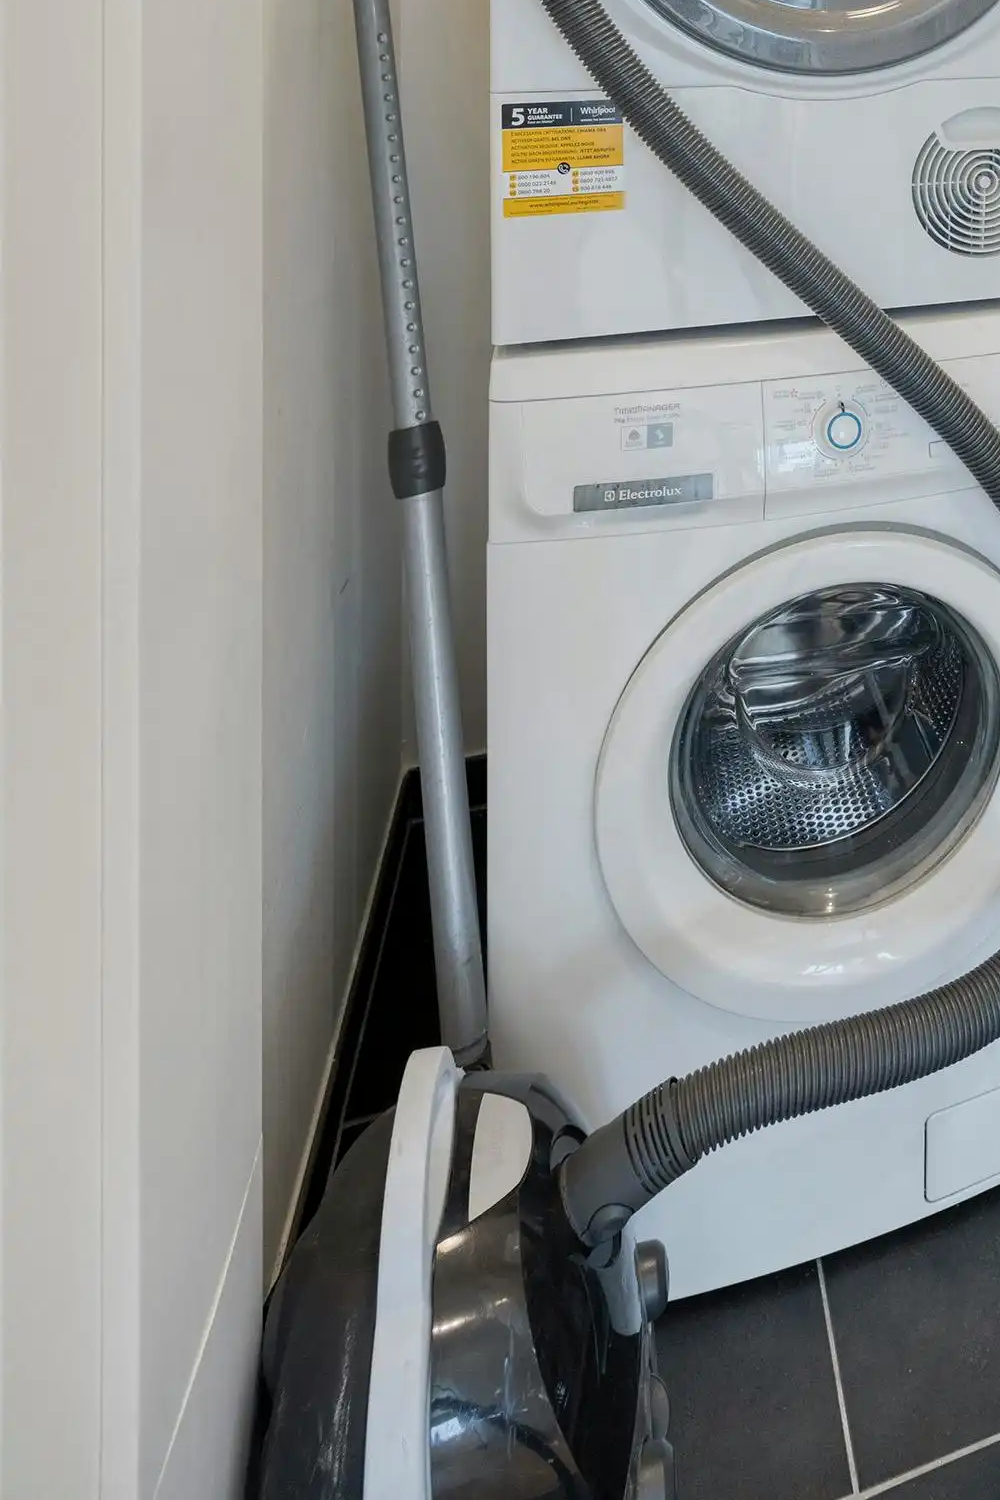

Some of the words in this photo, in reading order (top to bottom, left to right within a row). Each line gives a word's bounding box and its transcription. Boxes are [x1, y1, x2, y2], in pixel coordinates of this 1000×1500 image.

[511, 107, 525, 126] 5
[527, 107, 548, 115] YEAR
[527, 113, 563, 121] GUARANTEE
[580, 105, 616, 118] Whirlpool
[618, 487, 682, 501] Electrolux
